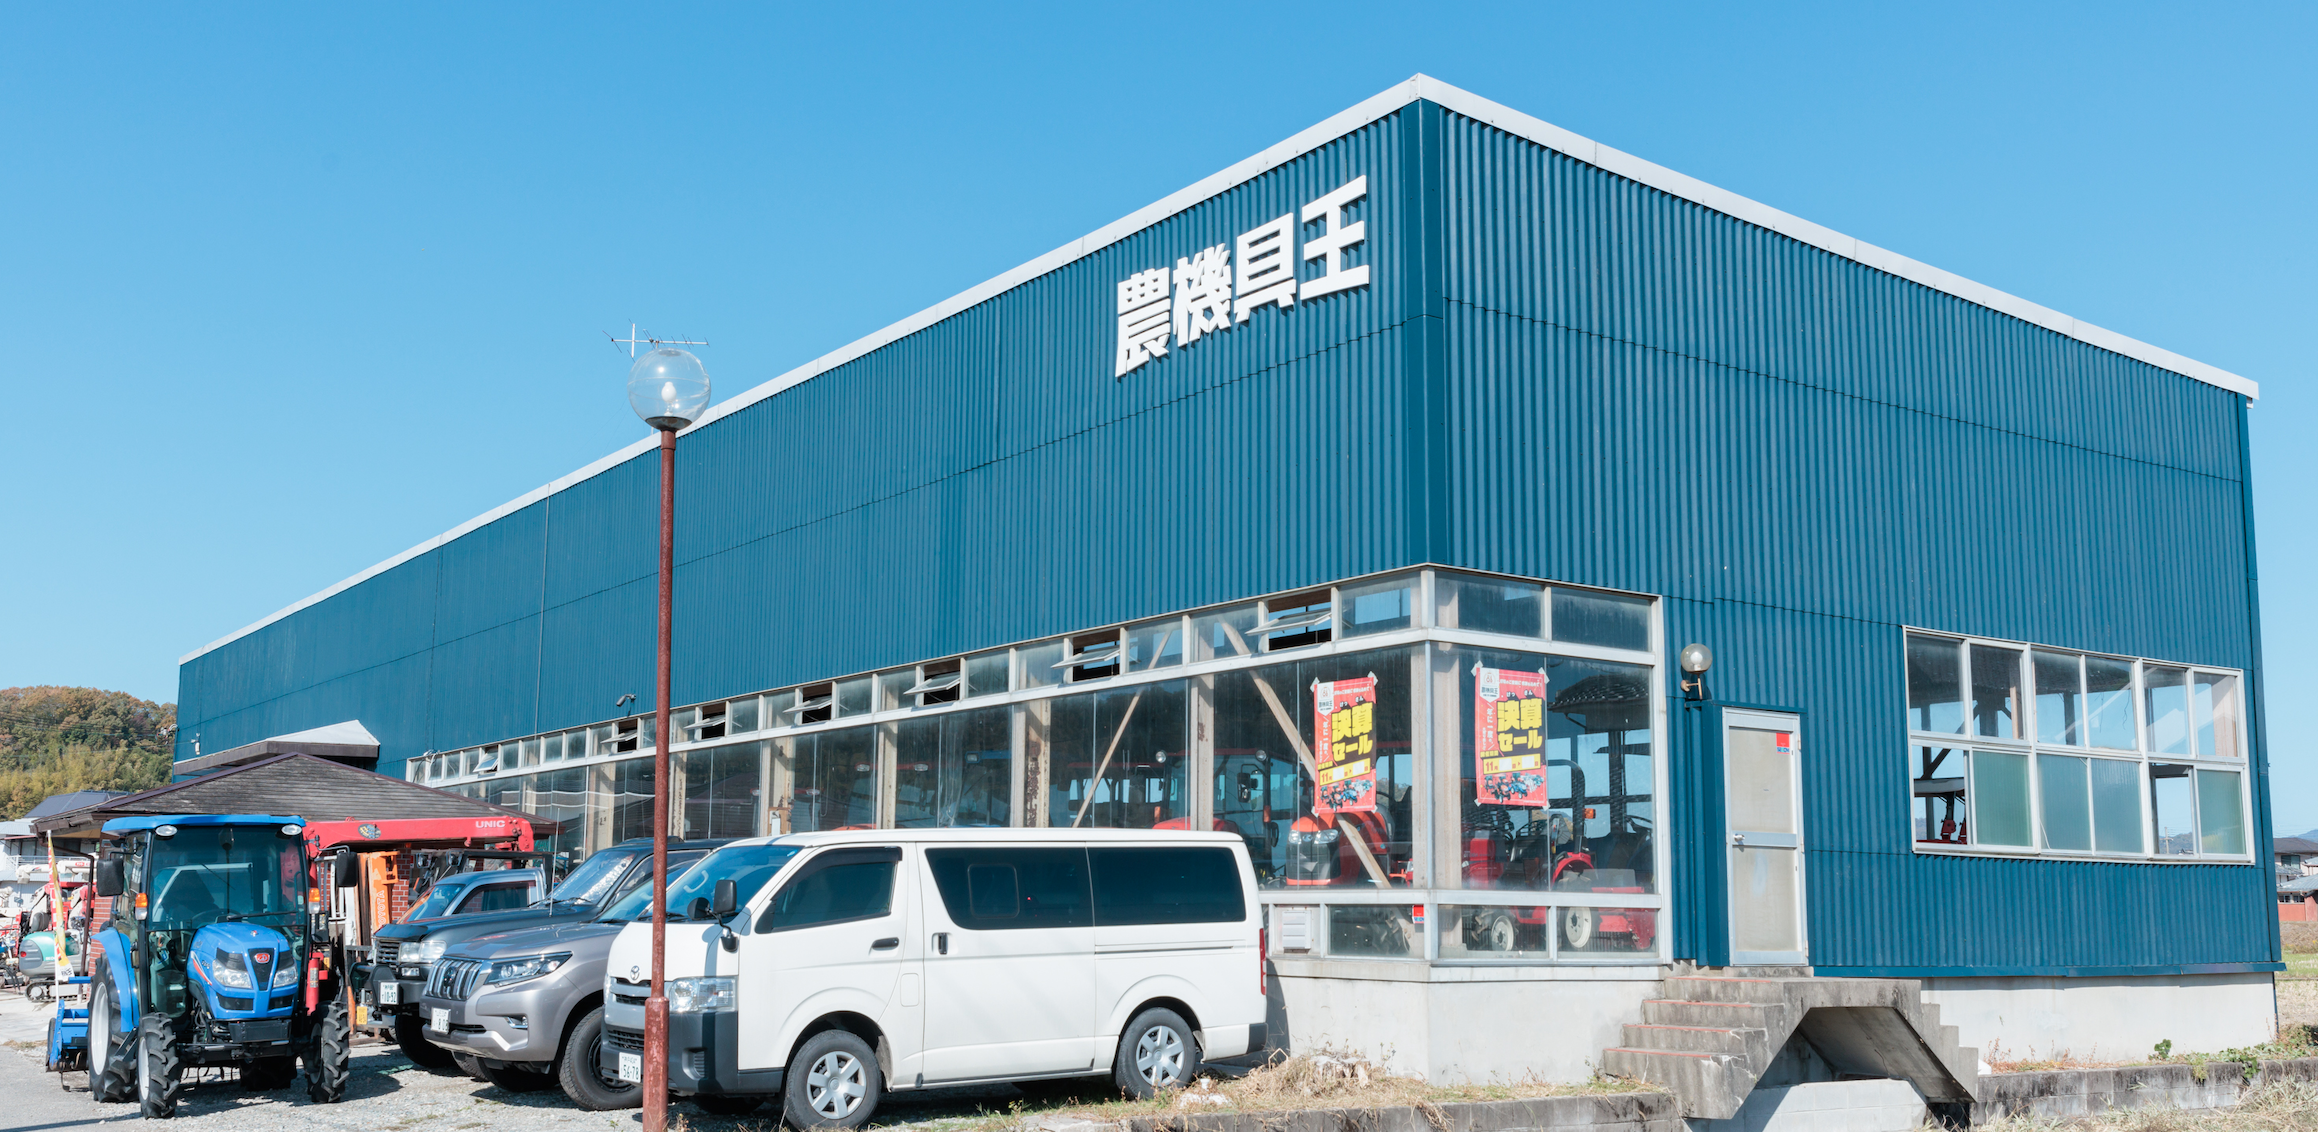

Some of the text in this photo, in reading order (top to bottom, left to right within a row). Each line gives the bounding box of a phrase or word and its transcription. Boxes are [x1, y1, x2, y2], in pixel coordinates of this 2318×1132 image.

[1115, 175, 1369, 378] 農機具王
[1331, 702, 1373, 743] 決算
[1497, 698, 1543, 732] 決算
[1332, 734, 1373, 762] セール
[1498, 729, 1543, 752] セール
[475, 820, 506, 828] UNIC
[623, 1064, 639, 1080] 56-78
